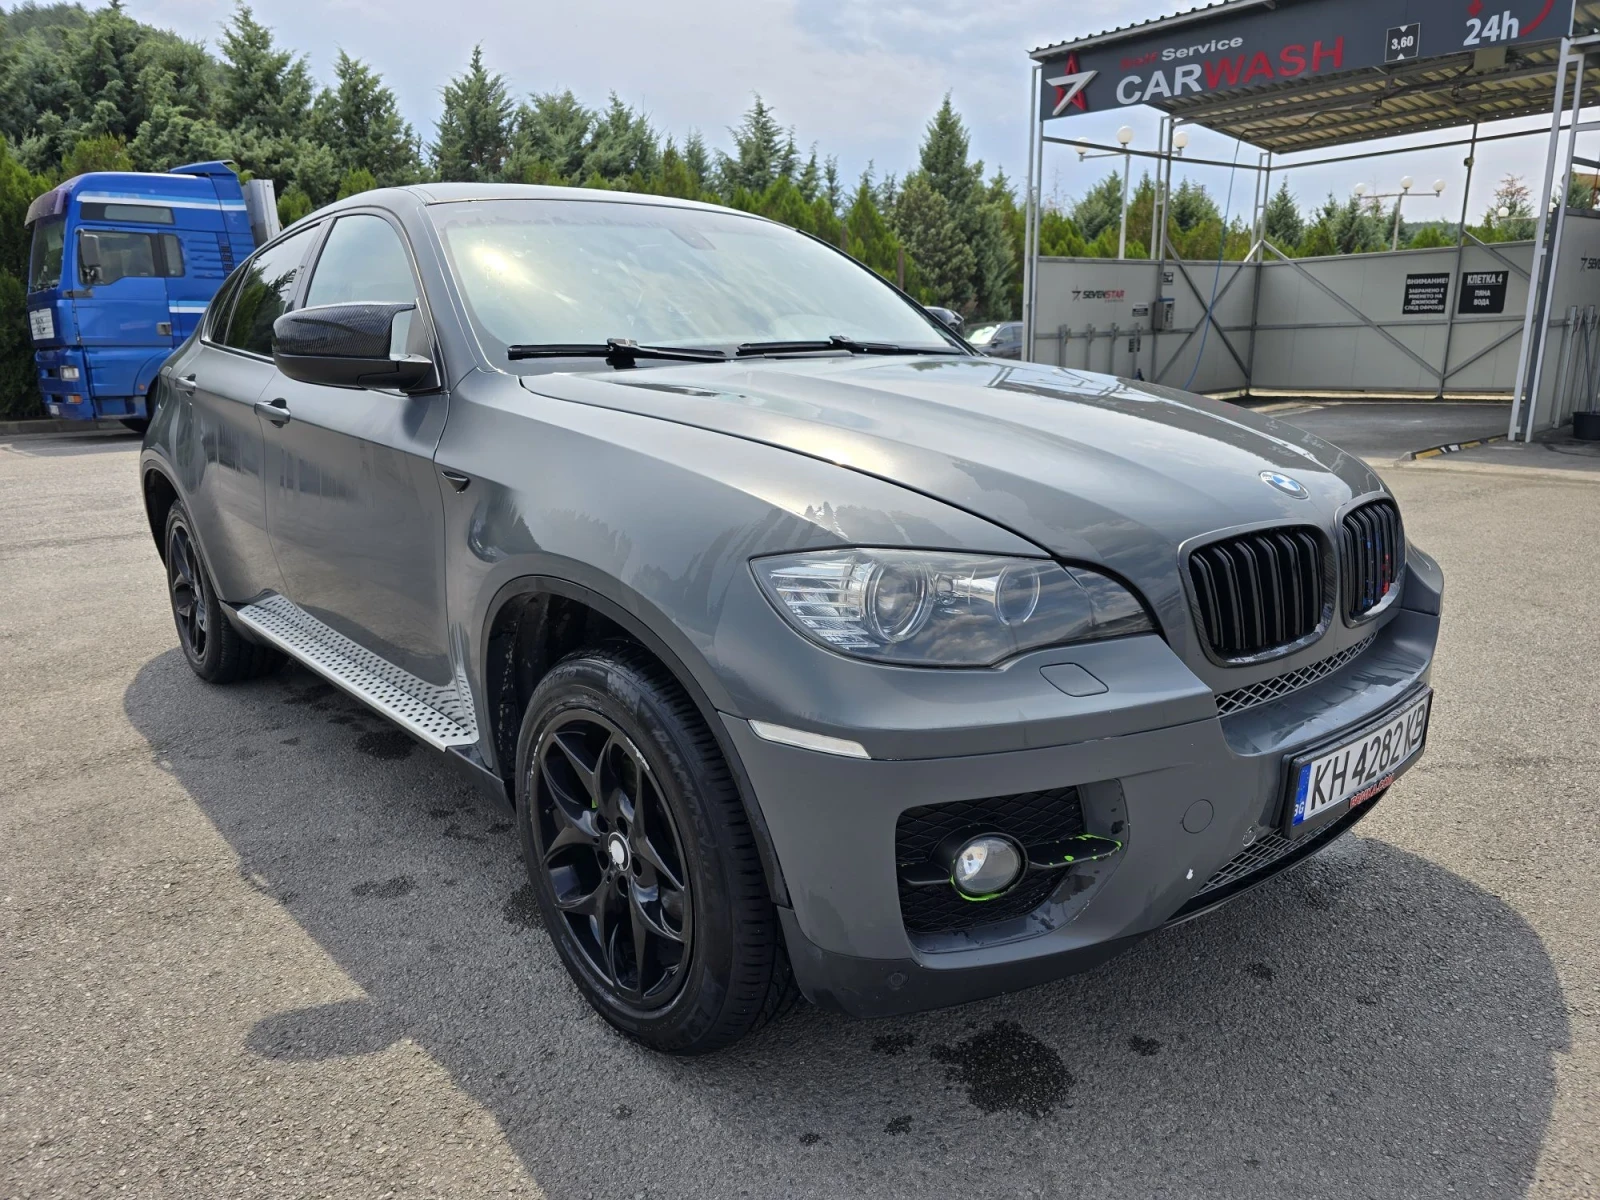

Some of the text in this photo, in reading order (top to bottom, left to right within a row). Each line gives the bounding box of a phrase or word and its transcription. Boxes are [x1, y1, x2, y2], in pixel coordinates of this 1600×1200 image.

[1463, 10, 1520, 46] 24h
[1161, 36, 1243, 61] Service
[1391, 35, 1414, 50] 3,60
[1467, 273, 1503, 284] КЛЕТКА 4
[1474, 289, 1491, 297] ПЯНА
[1473, 298, 1490, 306] ВОДА
[1351, 721, 1404, 786] 4282
